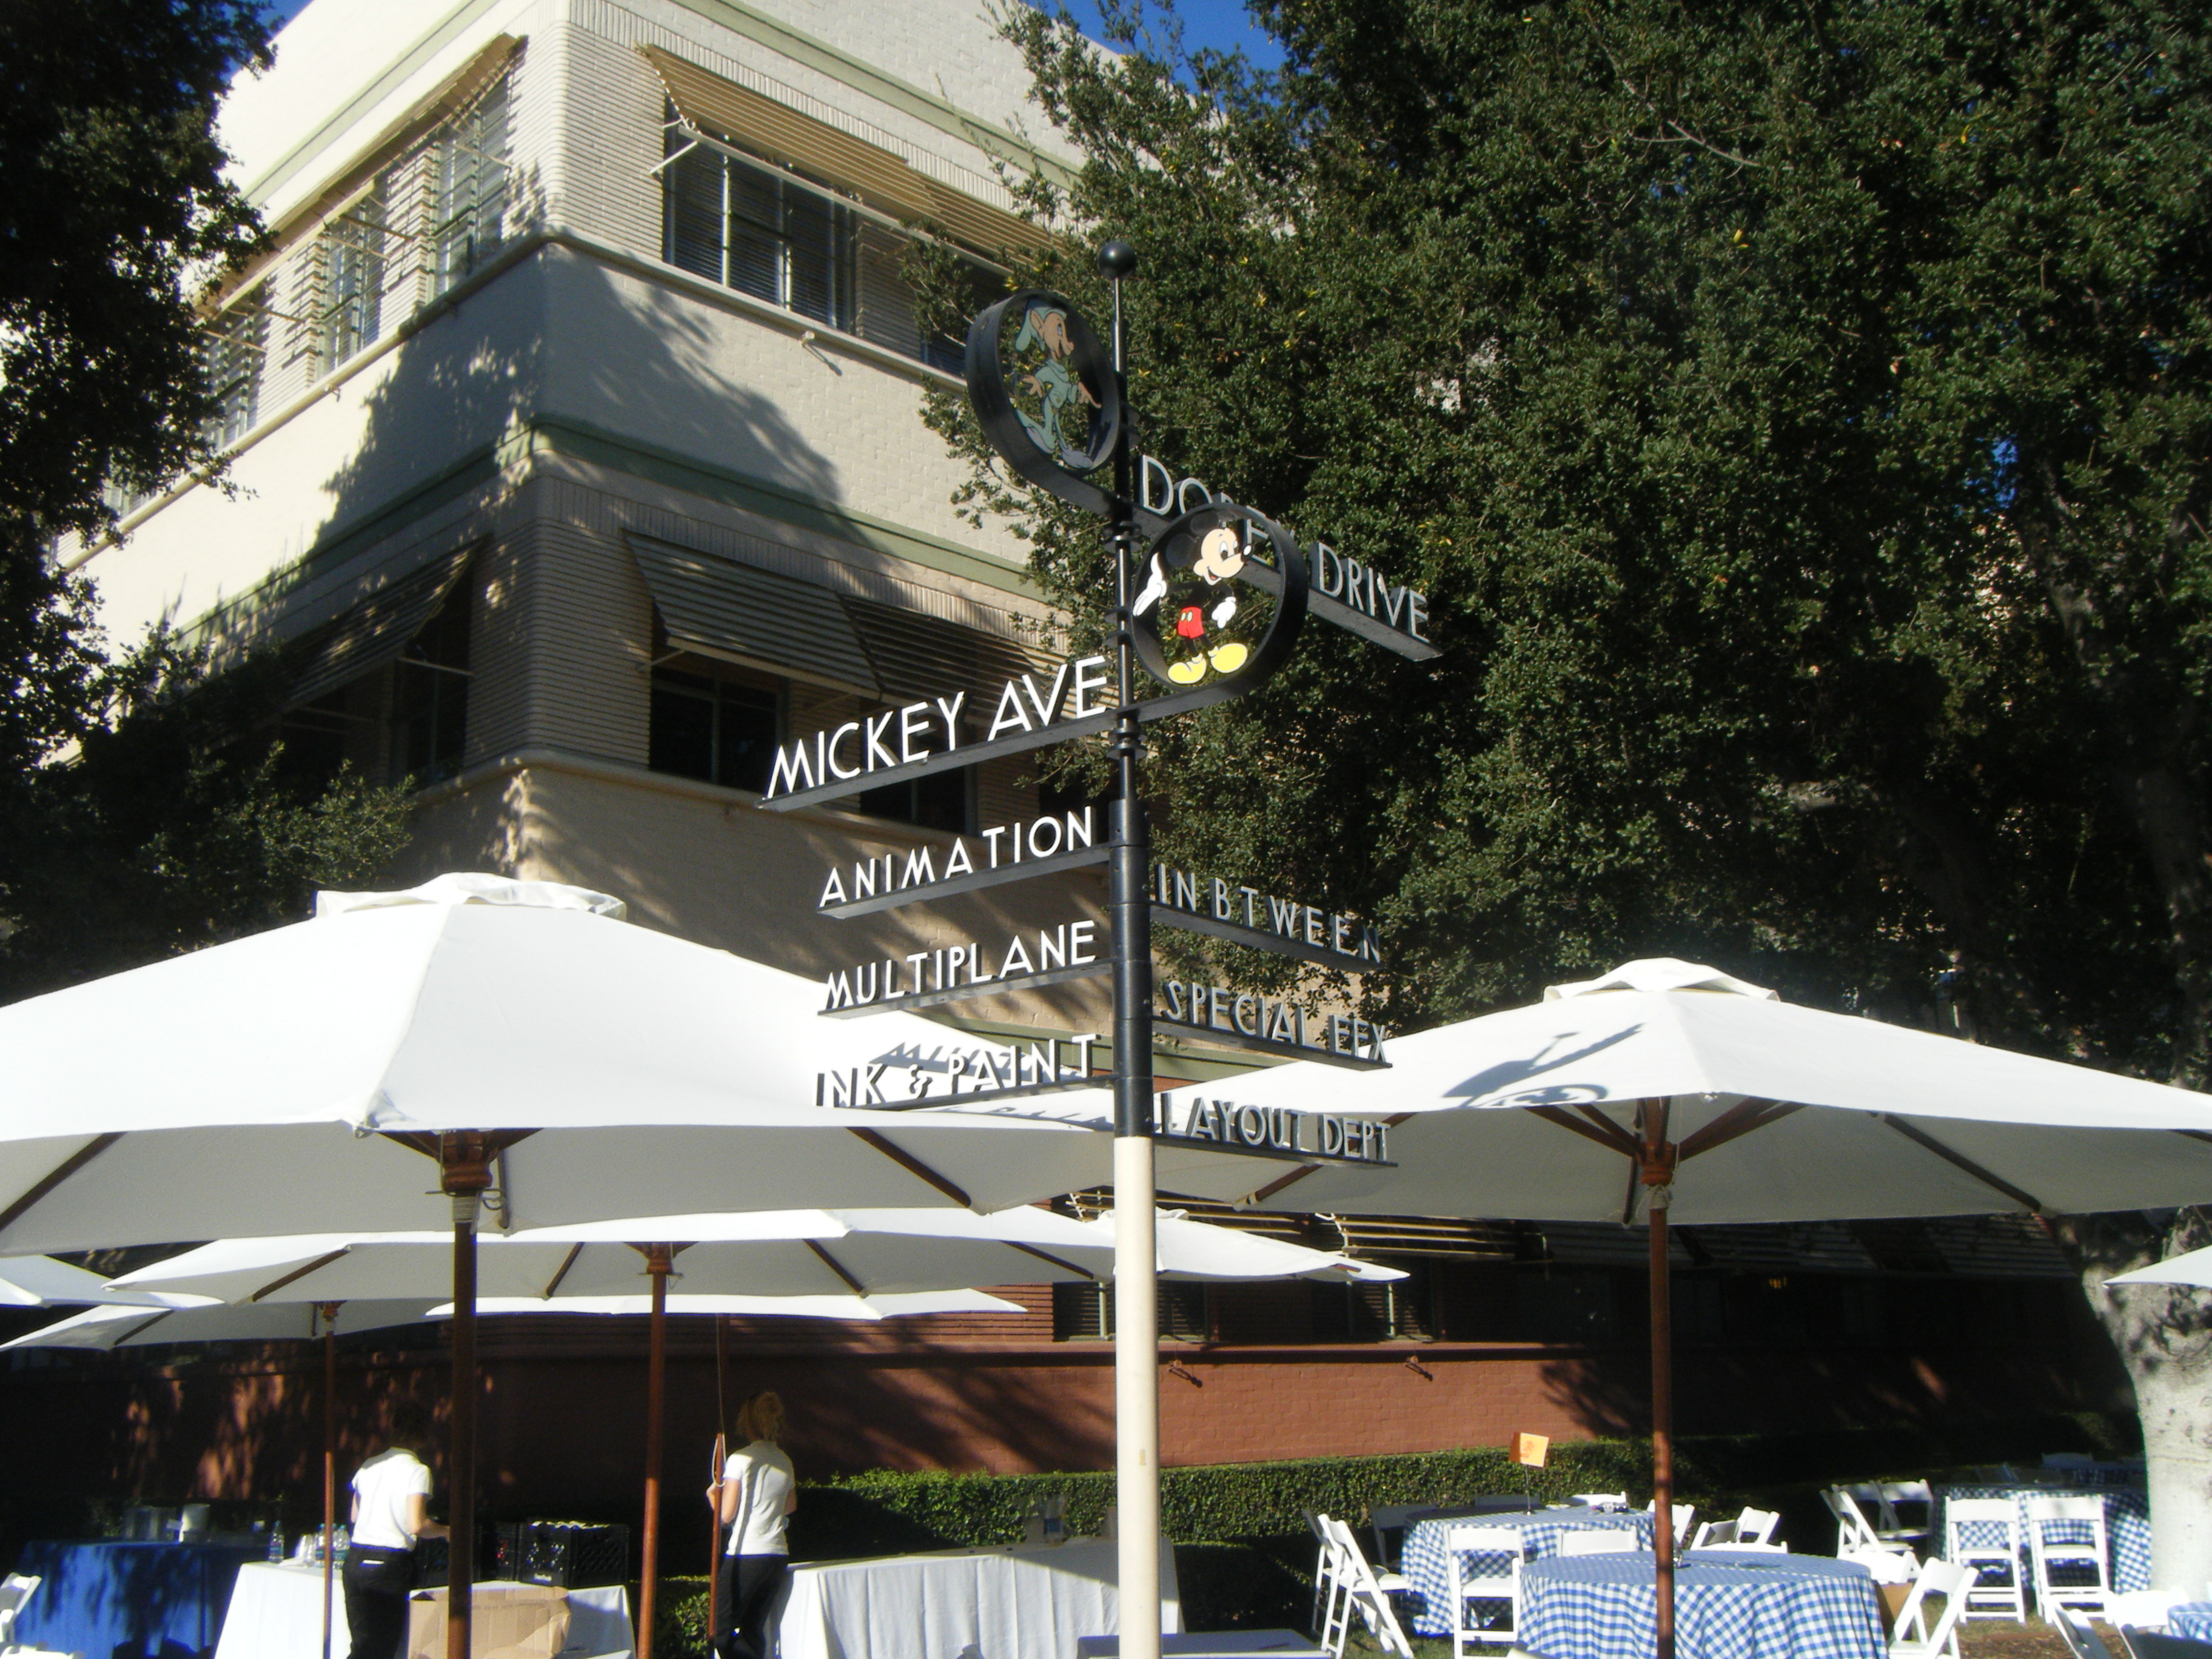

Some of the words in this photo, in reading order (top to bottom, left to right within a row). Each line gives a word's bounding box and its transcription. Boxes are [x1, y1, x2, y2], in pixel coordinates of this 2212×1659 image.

[1315, 541, 1429, 643] DRIVE
[766, 691, 965, 799] MICKEY
[987, 655, 1107, 741] AVE
[819, 805, 1092, 908] ANIMATION
[825, 920, 1097, 1010] MULTIPLANE
[1163, 980, 1318, 1048] SPECIAL
[1330, 1014, 1387, 1062] EFX
[813, 1062, 888, 1108] INK
[908, 1064, 933, 1099] &
[948, 1033, 1100, 1095] PAINT
[1162, 1092, 1308, 1150] LAYOUT
[1320, 1113, 1391, 1161] DEPT
